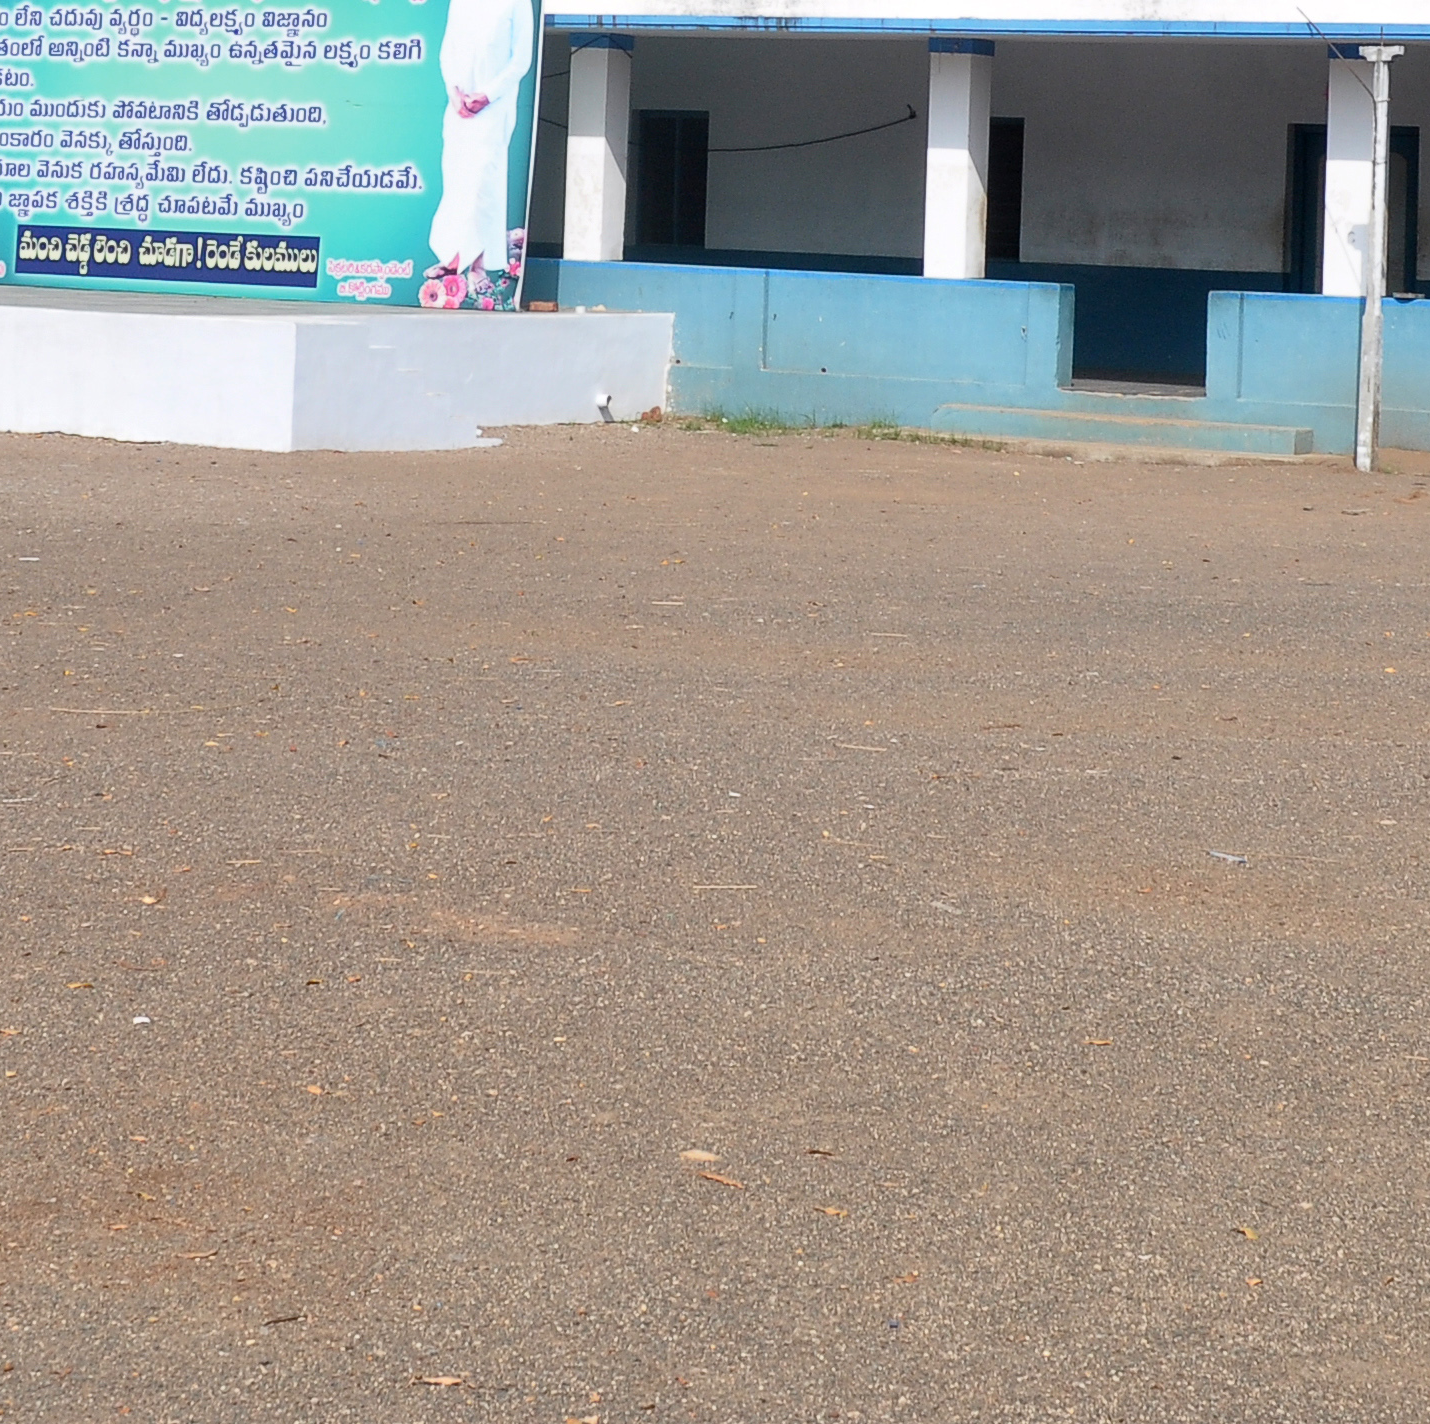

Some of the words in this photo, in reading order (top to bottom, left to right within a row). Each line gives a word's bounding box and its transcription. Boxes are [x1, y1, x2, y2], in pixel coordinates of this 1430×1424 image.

[14, 5, 42, 26] లేని
[49, 9, 103, 30] చదువు
[262, 8, 328, 37] విజ్ఞానం
[48, 38, 110, 62] అన్నింటి
[117, 40, 159, 63] కన్నా
[164, 39, 221, 66] ముఖ్యం
[229, 40, 316, 66] ఉన్నతమైన
[324, 40, 370, 68] లక్ష్యం
[377, 39, 422, 60] కలిగి
[30, 99, 106, 118] ముందుకు
[112, 100, 199, 120] పోవటానికి
[60, 130, 114, 156] వెనక్కు
[119, 129, 192, 157] తోస్తుంది.
[37, 160, 84, 179] వెనుక
[192, 161, 232, 184] లేదు.
[239, 166, 298, 194] కష్టించి
[9, 192, 59, 217] జ్ఞాపక
[65, 191, 107, 217] శక్తికి
[114, 194, 149, 222] శ్రద్ధ
[158, 193, 238, 215] చూపటమే
[244, 198, 304, 226] ముఖ్యం
[19, 230, 62, 261] మంచి
[205, 235, 243, 269] రెండే
[244, 240, 317, 273] కులములు
